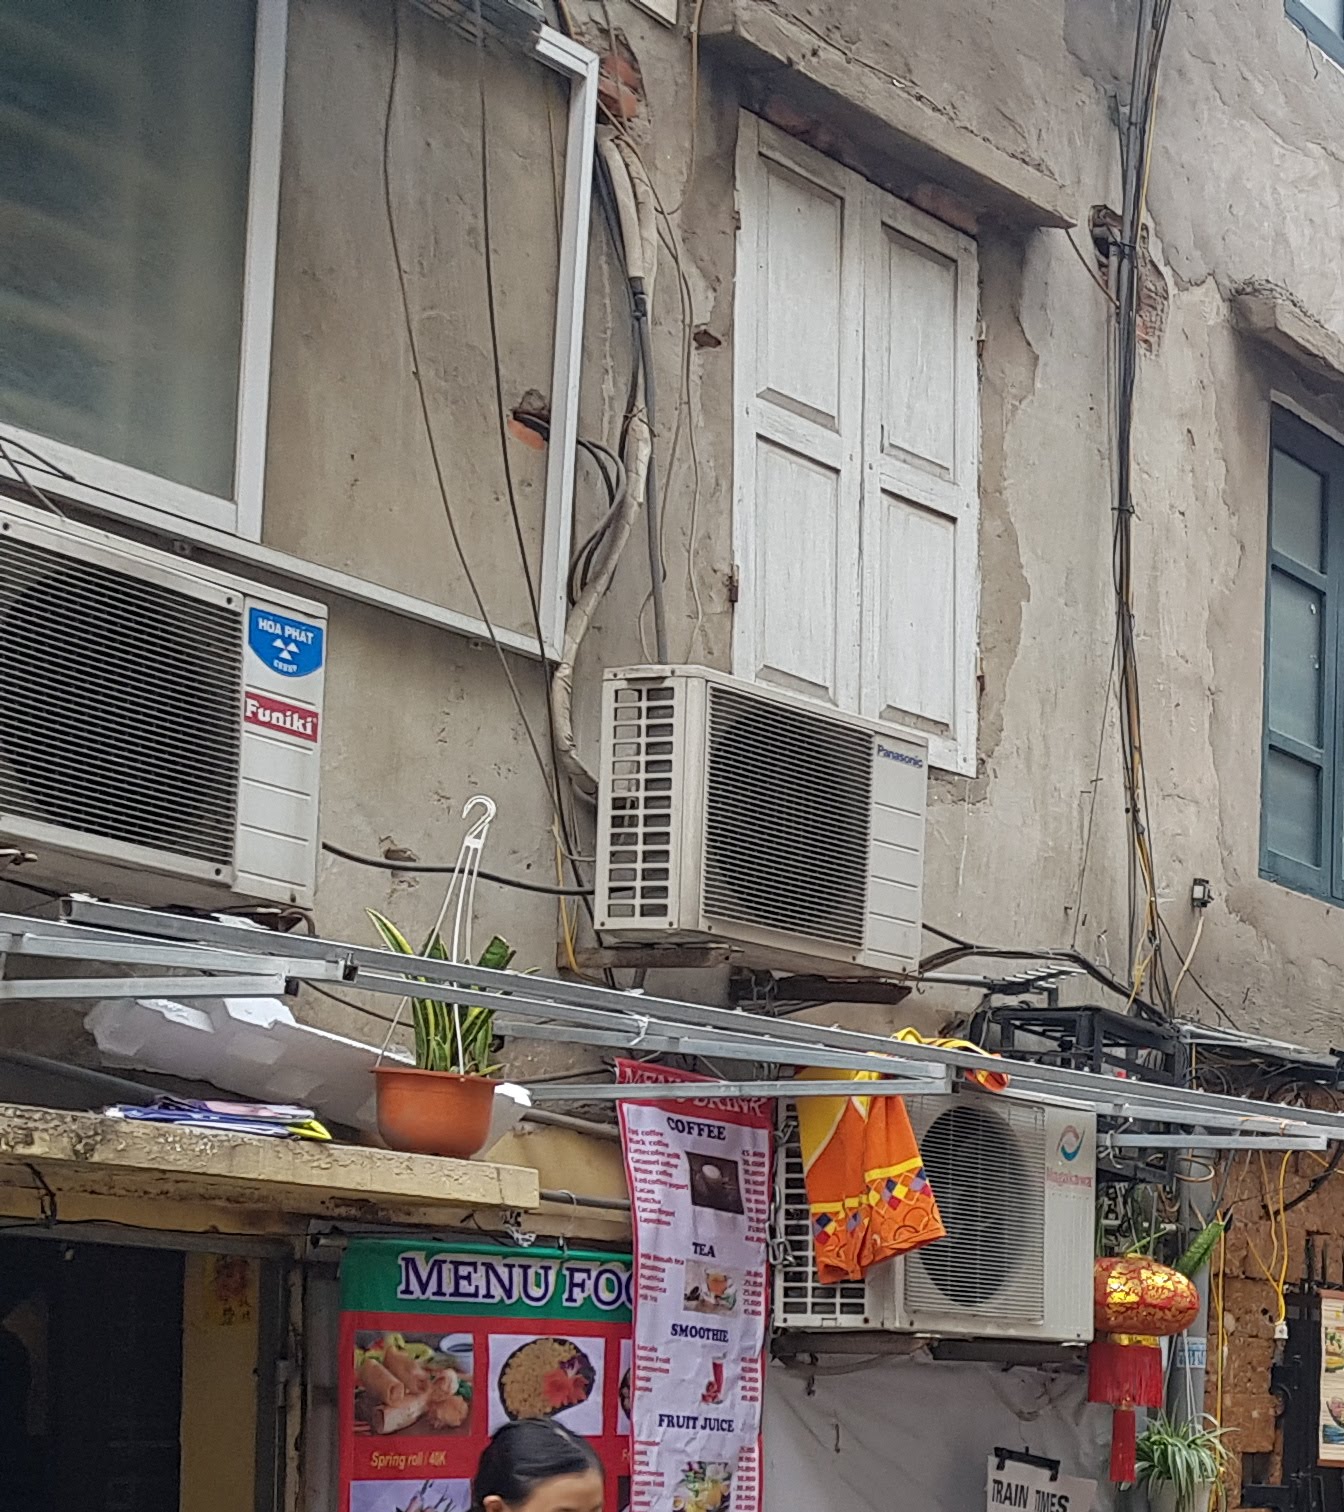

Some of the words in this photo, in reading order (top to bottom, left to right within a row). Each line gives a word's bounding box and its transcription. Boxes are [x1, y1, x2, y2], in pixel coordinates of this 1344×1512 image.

[245, 697, 313, 735] Funiki
[877, 743, 923, 769] Panasonic
[667, 1116, 727, 1141] COFFEE
[692, 1242, 716, 1258] TEA
[400, 1256, 553, 1303] MENU
[565, 1266, 633, 1307] FO
[670, 1323, 729, 1342] SMOOTHIE
[657, 1413, 699, 1428] FRUIT
[699, 1418, 735, 1433] JUICE
[371, 1451, 406, 1470] Spring
[407, 1451, 424, 1466] roll
[991, 1478, 1030, 1509] TRAIN
